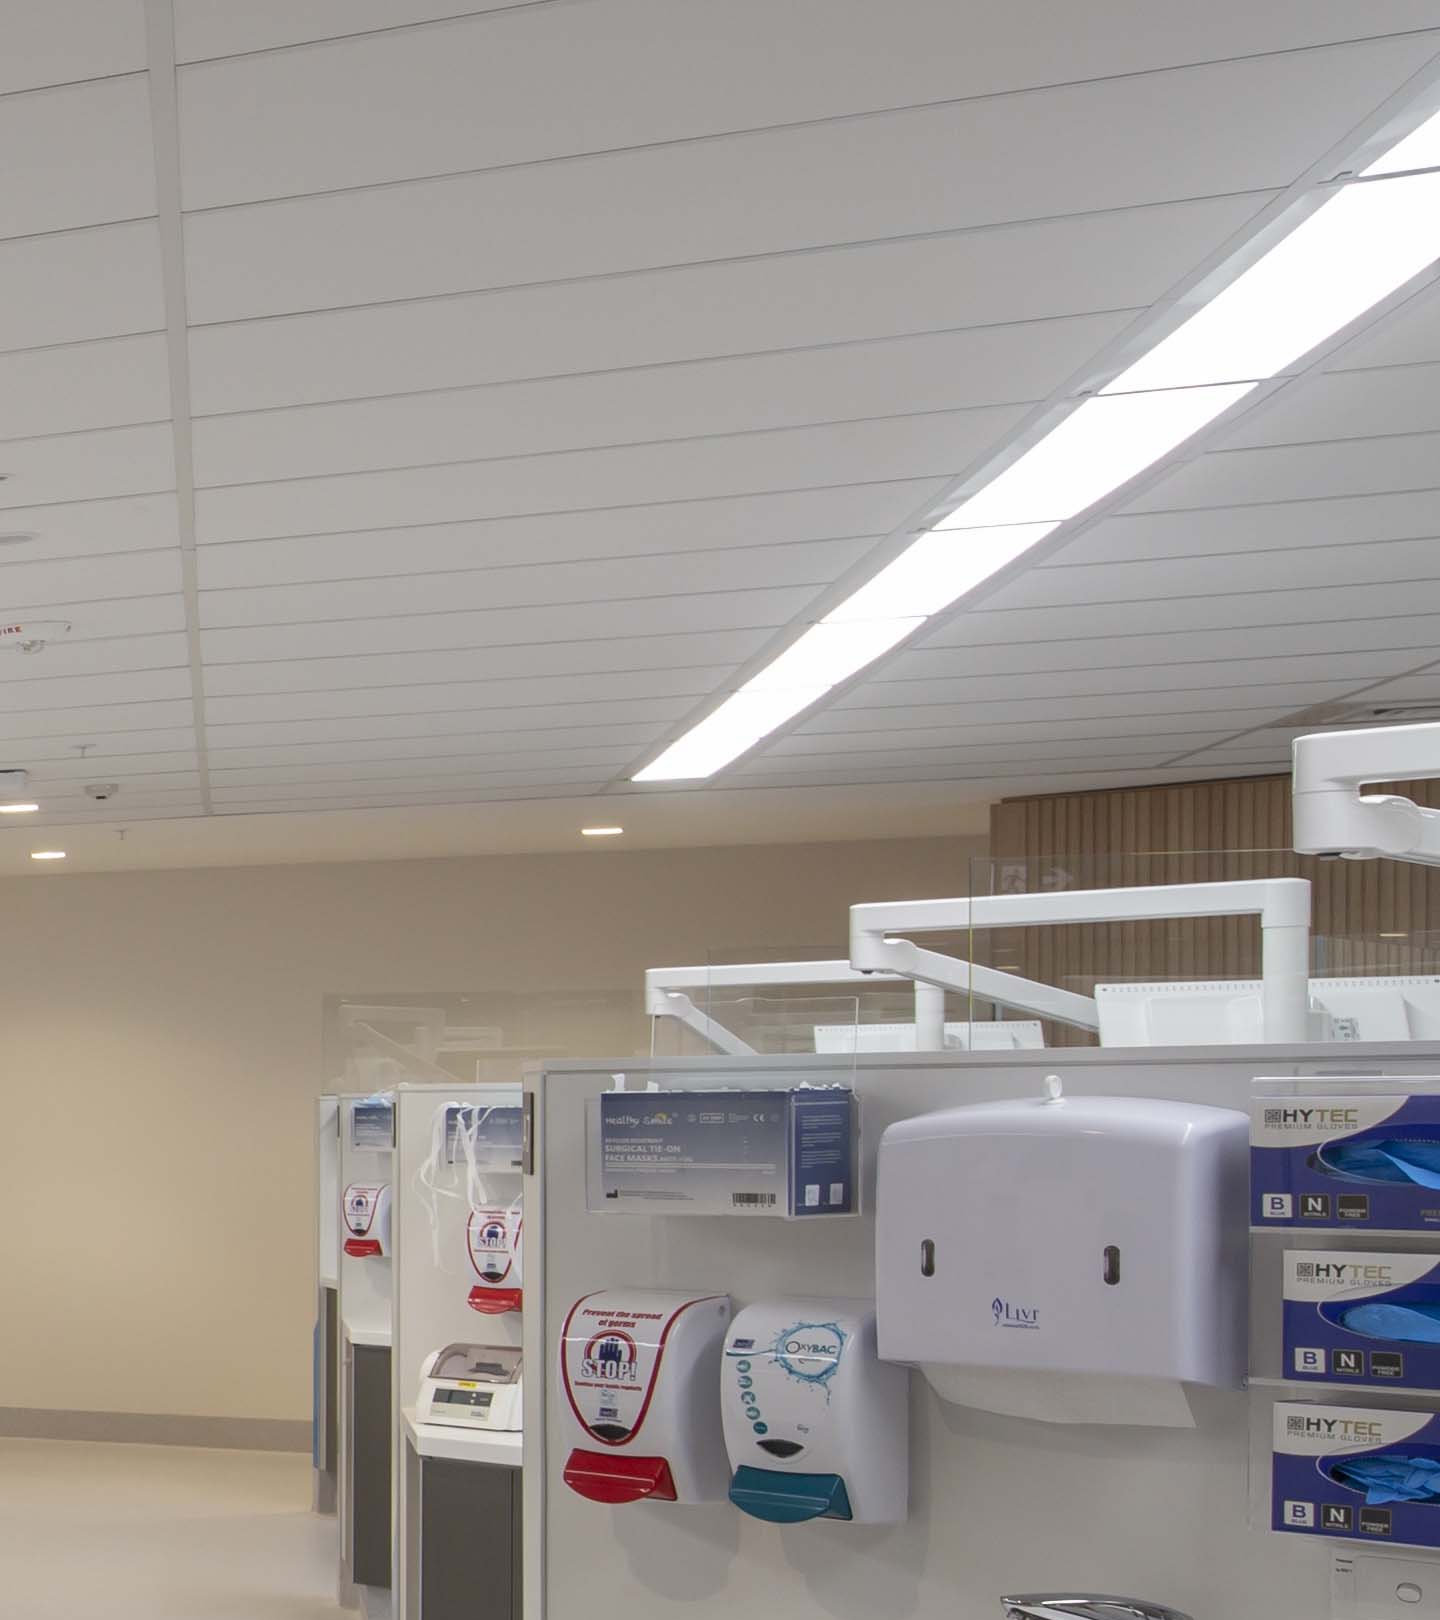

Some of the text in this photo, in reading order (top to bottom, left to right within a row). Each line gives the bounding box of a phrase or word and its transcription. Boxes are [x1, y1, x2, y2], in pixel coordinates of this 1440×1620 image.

[1282, 1108, 1358, 1122] HYTEC
[1271, 1197, 1284, 1210] B
[1308, 1197, 1322, 1211] N
[1315, 1263, 1392, 1280] HYTEC
[1296, 1277, 1345, 1285] PREMIUM
[582, 1309, 615, 1317] Prevent
[616, 1310, 630, 1318] the
[1303, 1351, 1317, 1365] B
[1340, 1353, 1355, 1367] N
[581, 1359, 637, 1381] STOP!
[1306, 1417, 1383, 1435] HYTEC
[1287, 1430, 1336, 1440] PREMIUM
[1292, 1504, 1307, 1519] B
[1329, 1508, 1345, 1523] N
